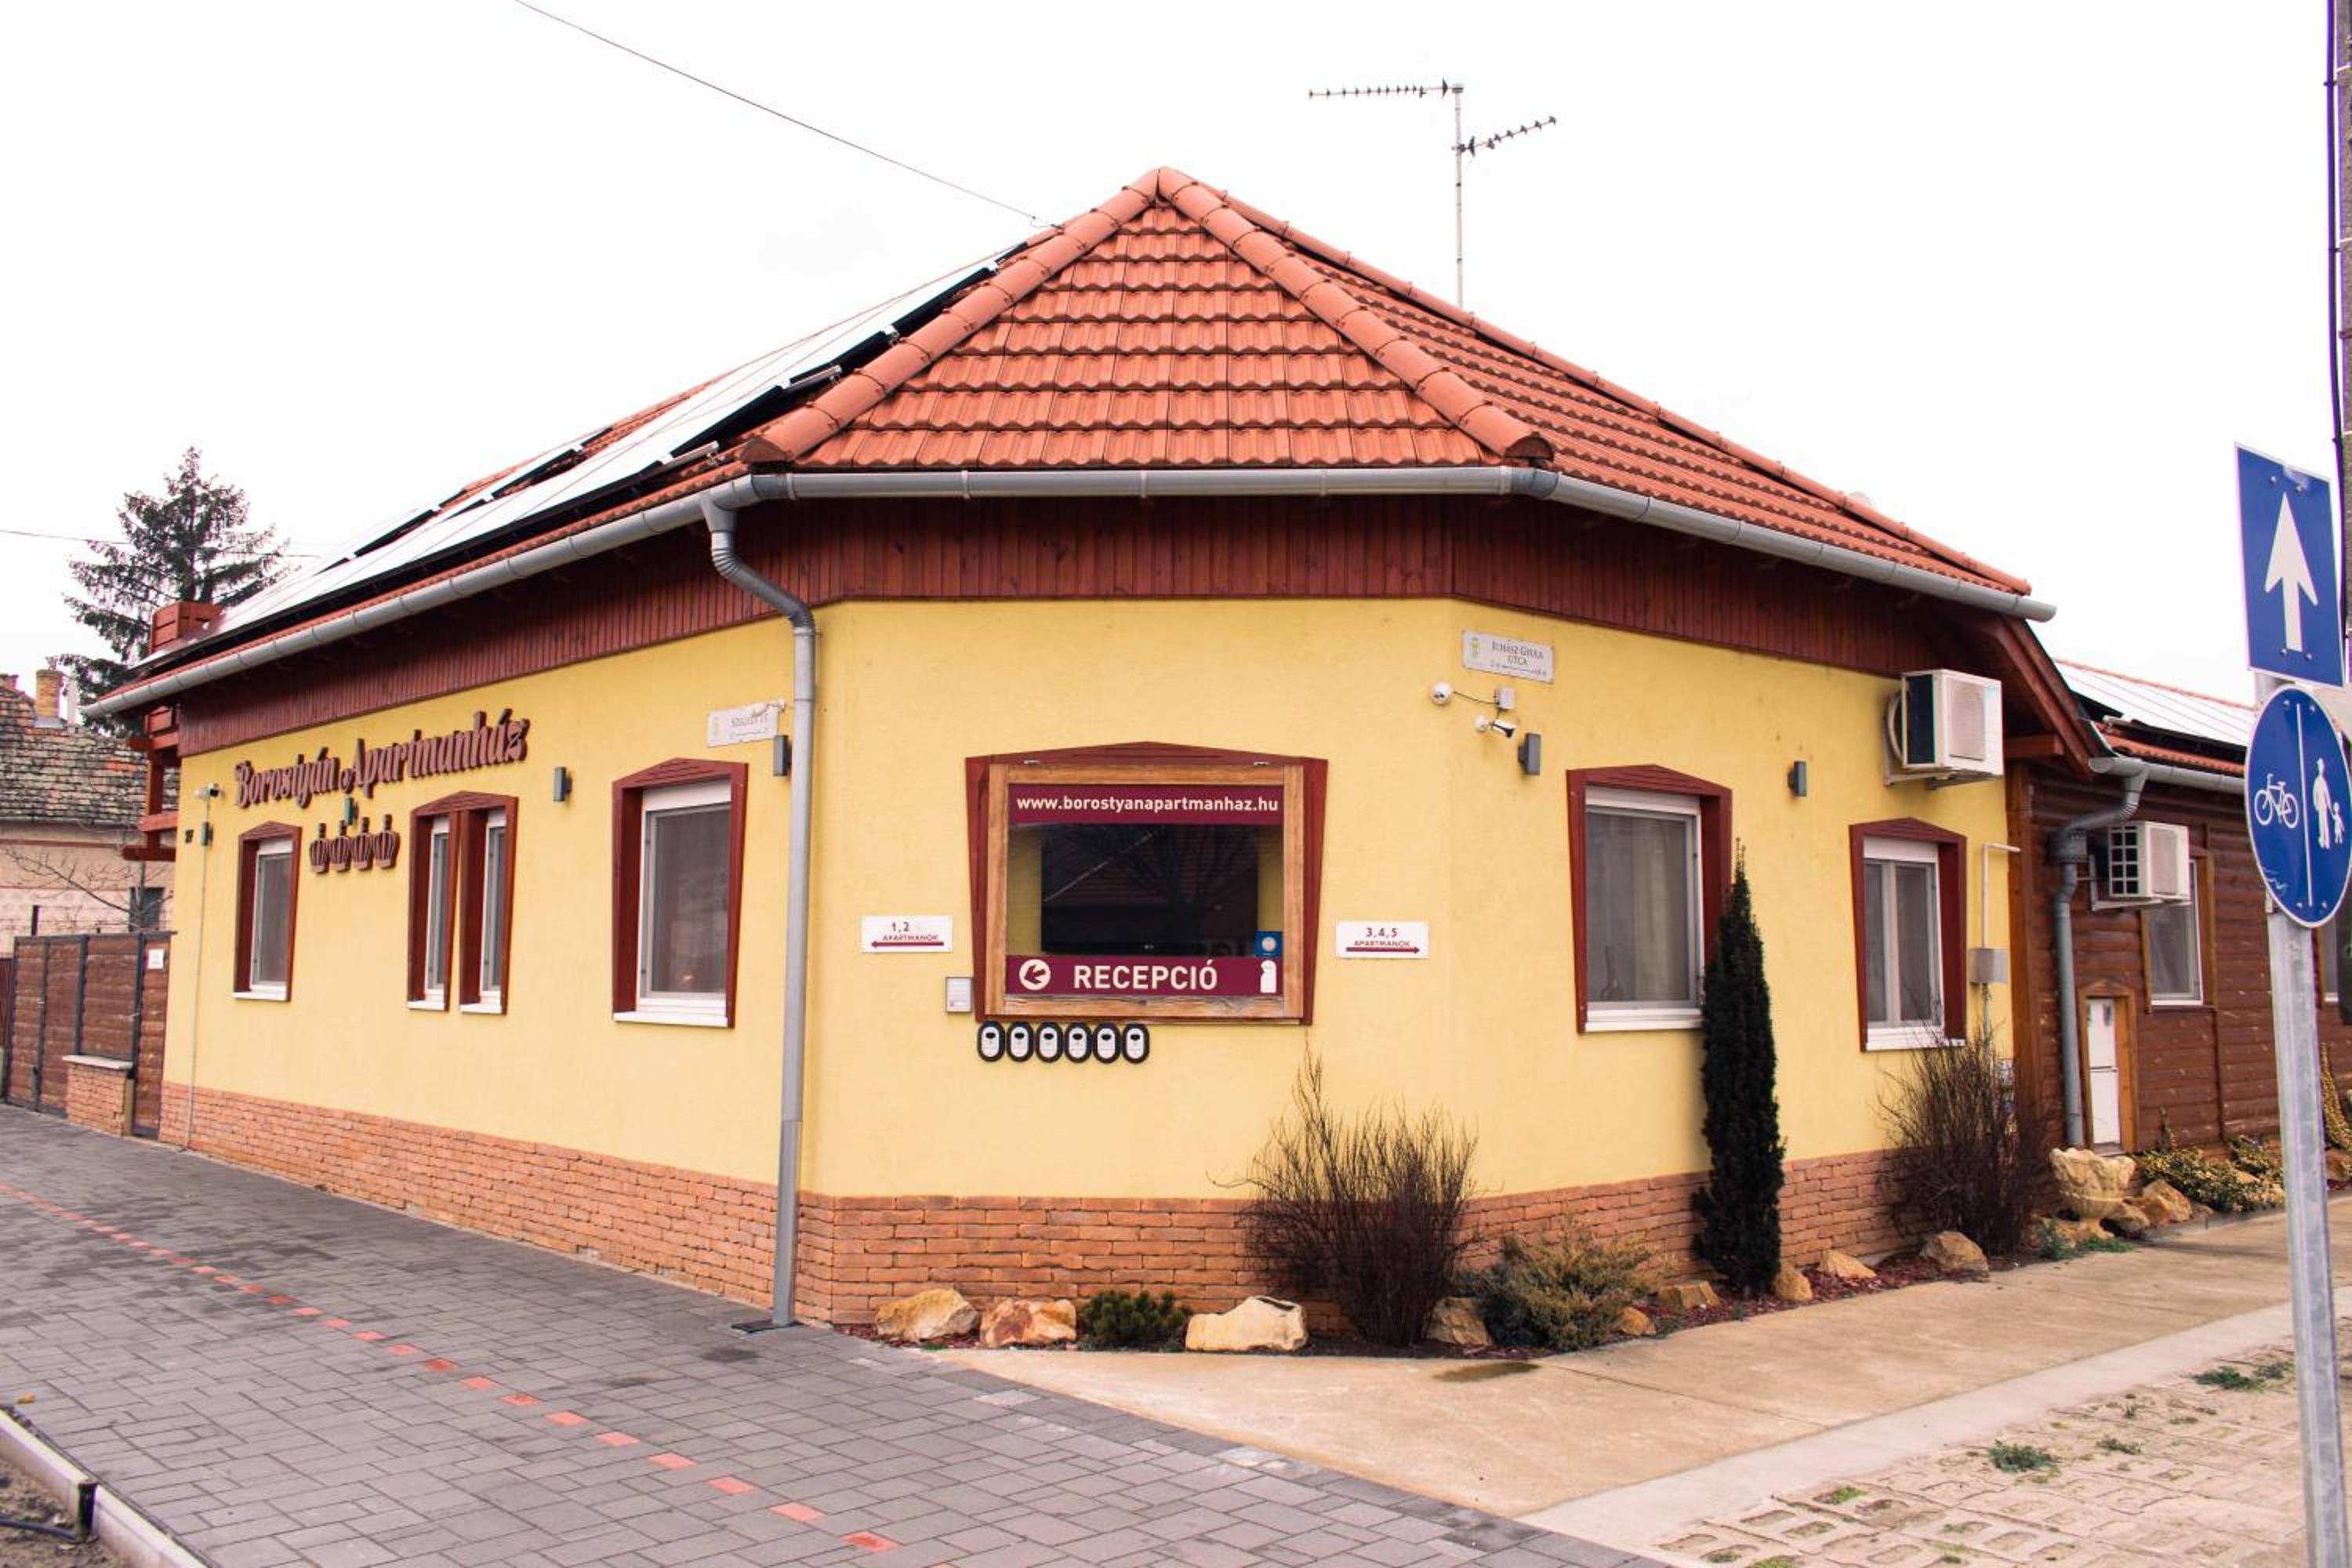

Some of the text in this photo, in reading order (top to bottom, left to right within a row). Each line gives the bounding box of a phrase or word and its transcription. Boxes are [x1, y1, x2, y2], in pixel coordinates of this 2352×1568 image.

[234, 709, 530, 808] Borostyán Apartmanház
[1017, 794, 1279, 813] www.borostyanapartmanhaz.hu
[1074, 959, 1218, 990] RECEPCIÓ
